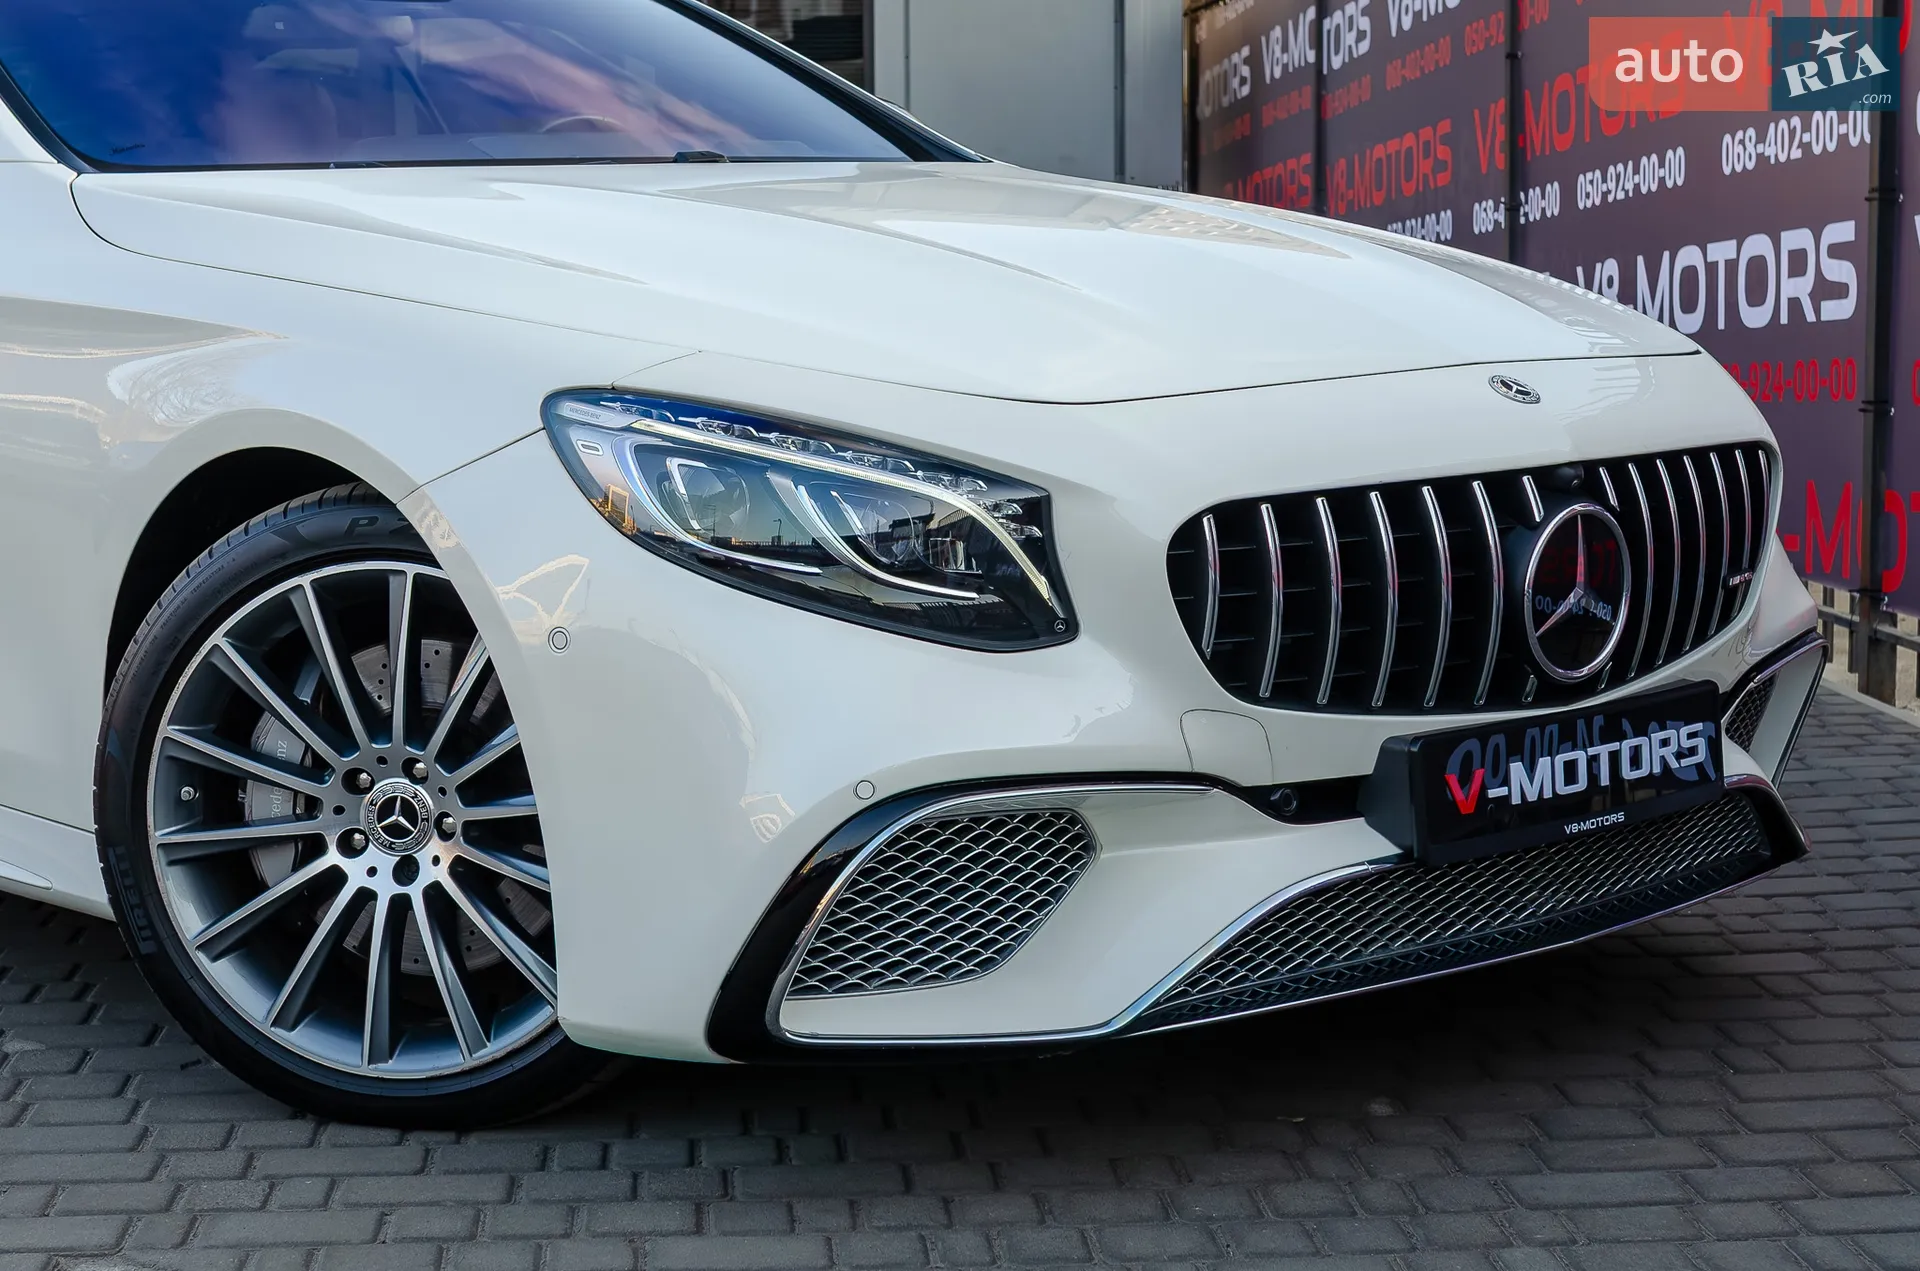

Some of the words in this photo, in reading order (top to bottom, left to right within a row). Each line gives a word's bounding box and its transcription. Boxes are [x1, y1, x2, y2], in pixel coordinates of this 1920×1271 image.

[1326, 118, 1453, 218] V8-MOTORS
[1576, 146, 1686, 210] 050-924-00-00
[1576, 220, 1858, 335] 8MOTORS
[1722, 356, 1858, 402] -924-00-00
[1444, 722, 1707, 815] V-MOTORS
[367, 805, 391, 848] MERCEDES
[413, 793, 429, 819] BENZ
